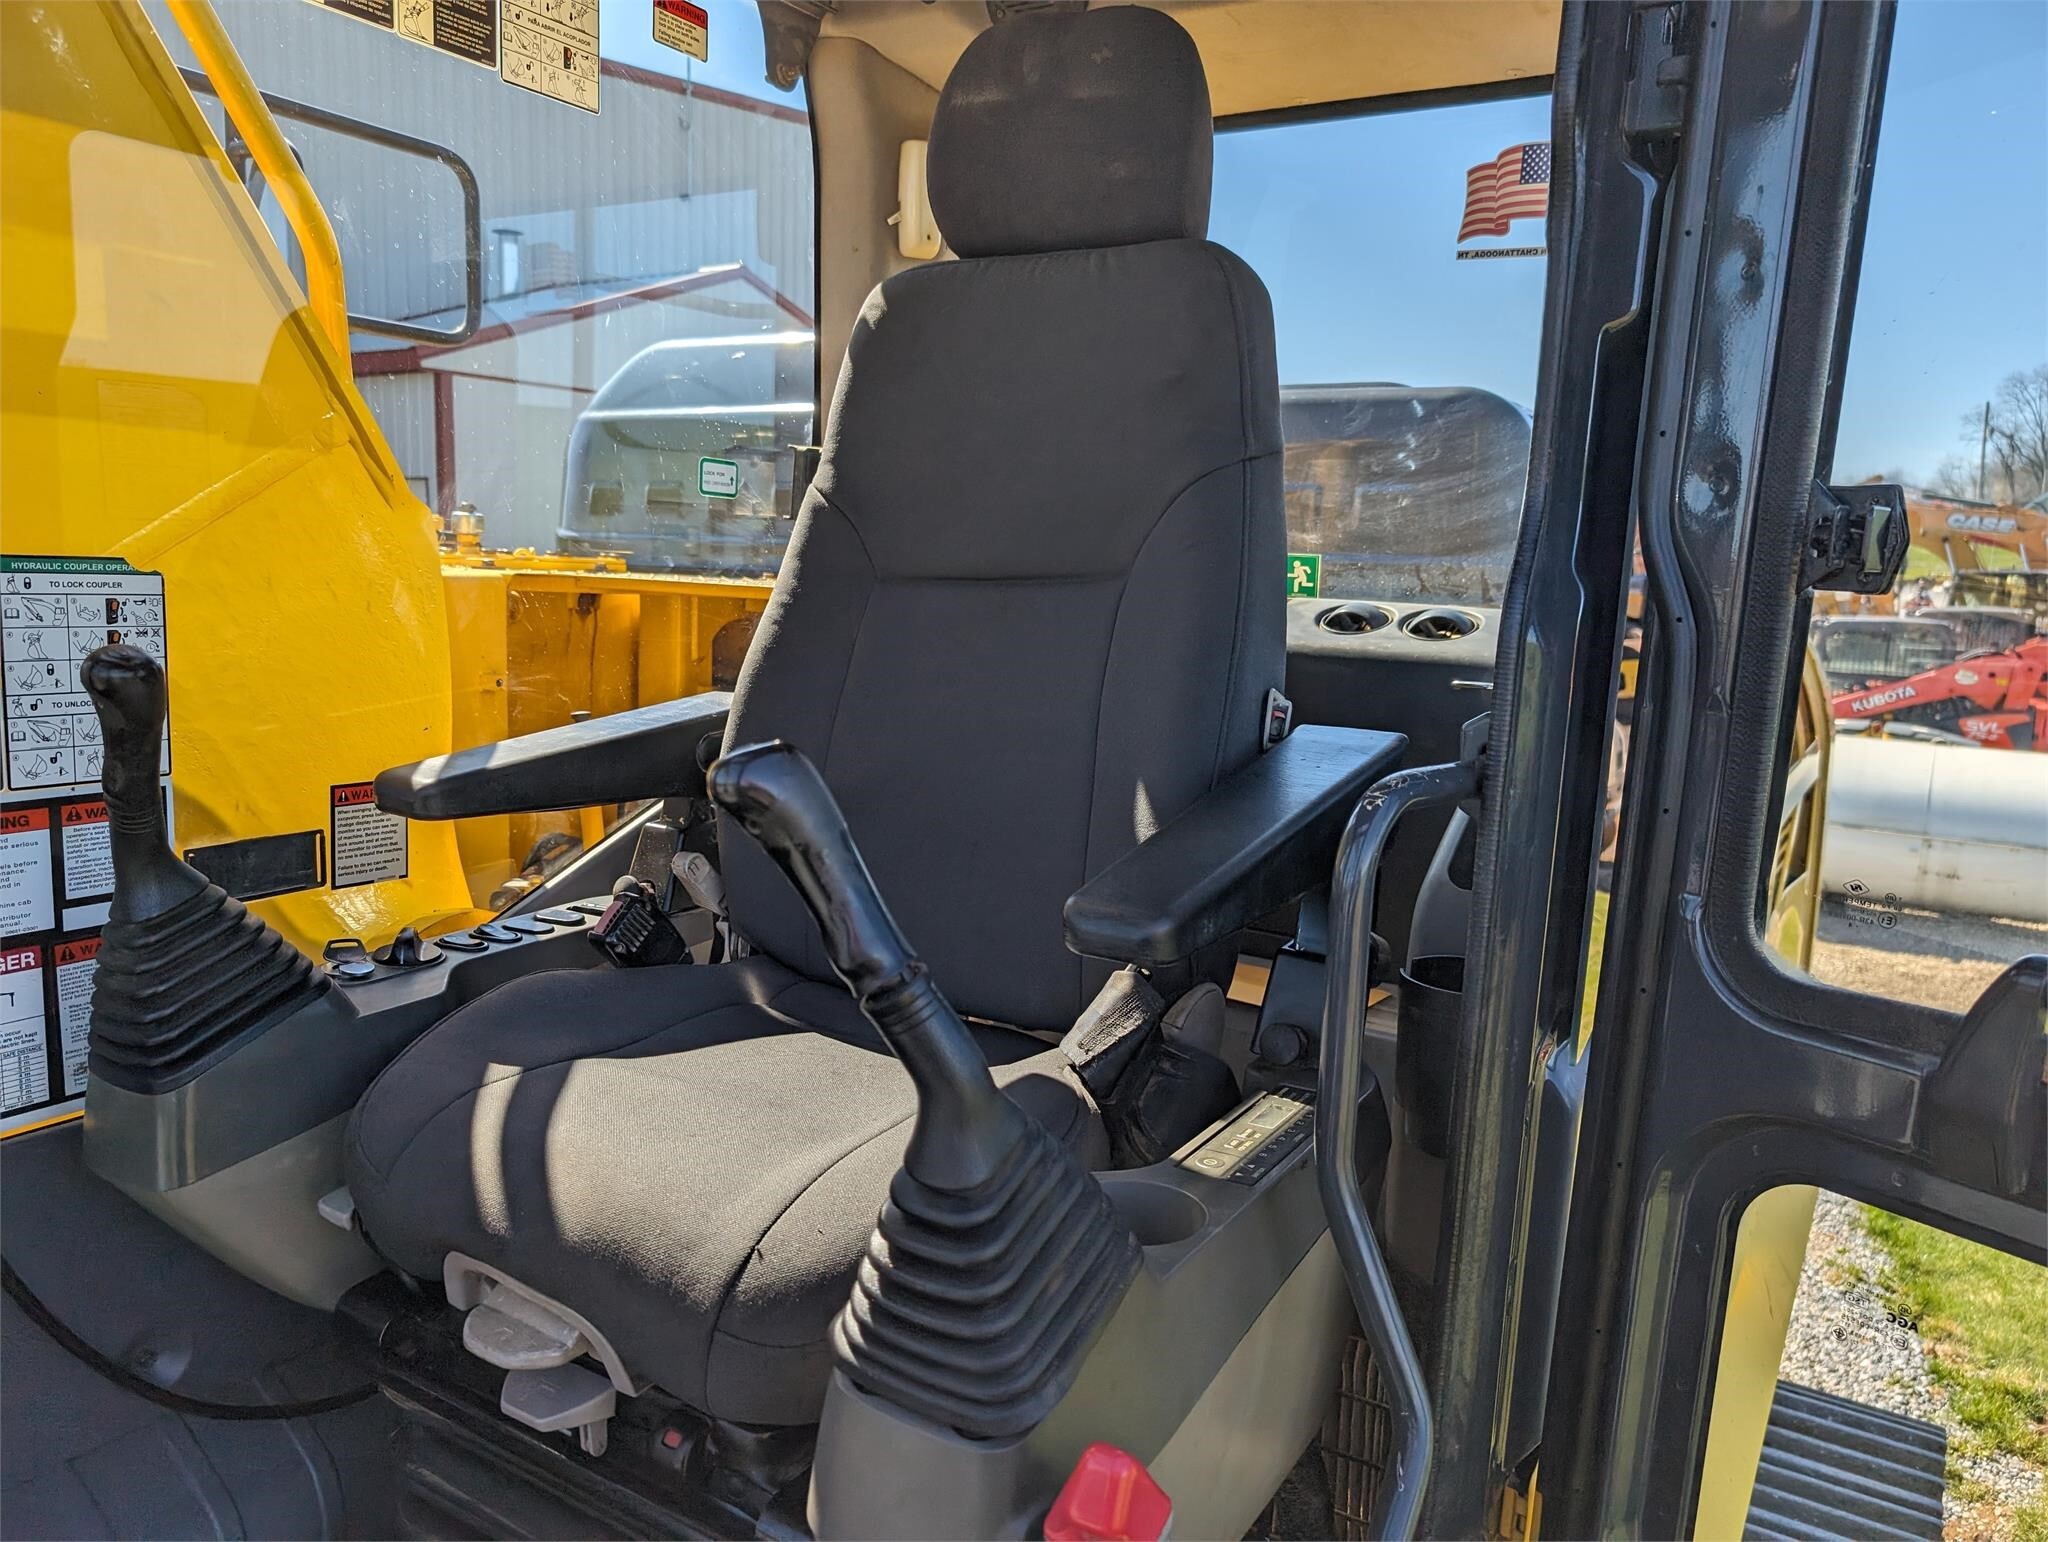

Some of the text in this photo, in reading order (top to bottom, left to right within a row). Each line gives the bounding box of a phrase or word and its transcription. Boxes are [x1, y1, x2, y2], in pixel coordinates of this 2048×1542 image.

[1946, 512, 2016, 533] CASE
[11, 562, 137, 572] HYDRAULIC COUPLER OPERA
[1851, 686, 1916, 712] KUBOTA
[85, 807, 109, 819] WA
[0, 815, 30, 829] ING
[0, 912, 31, 921] tributor
